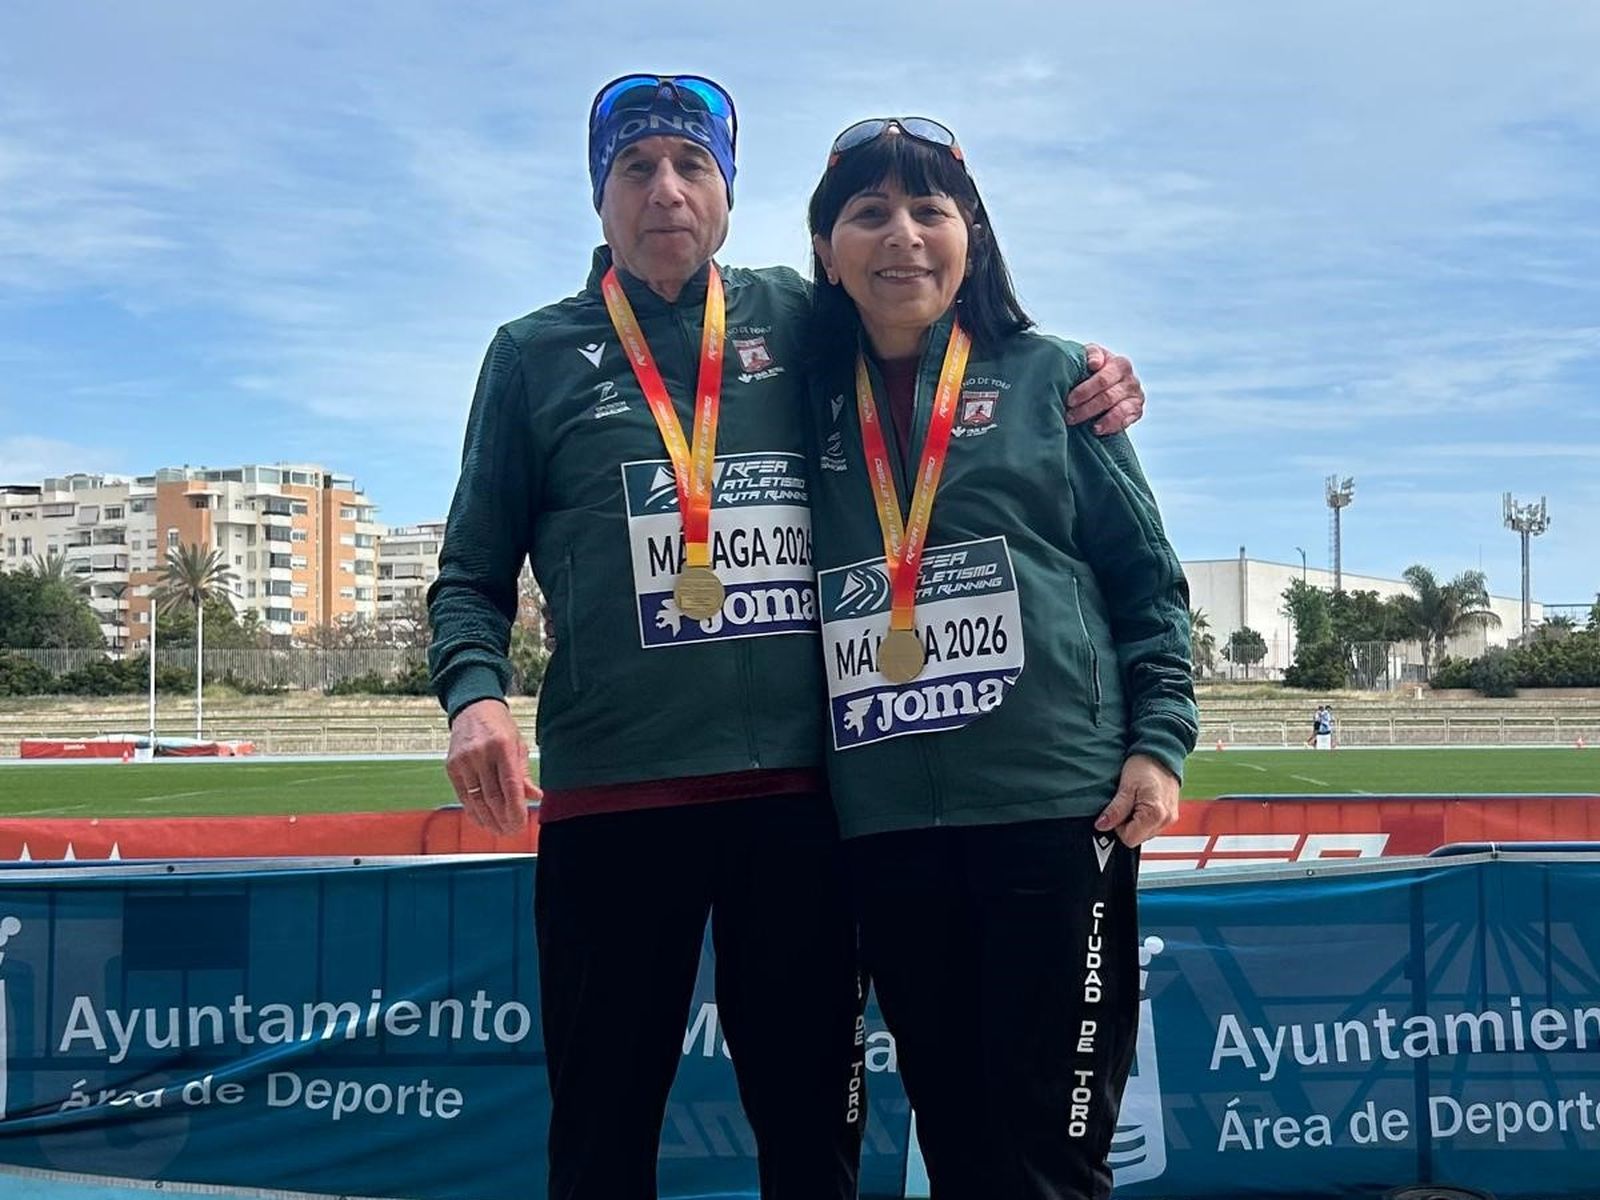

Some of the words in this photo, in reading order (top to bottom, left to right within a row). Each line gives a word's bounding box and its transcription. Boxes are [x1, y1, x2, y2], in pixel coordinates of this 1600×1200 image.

[726, 460, 788, 477] RFEA
[717, 490, 760, 504] RUTA
[647, 525, 770, 577] MÁAGA
[916, 563, 998, 586] LETISMO
[919, 551, 968, 575] FEA
[936, 576, 1004, 596] RUNNING
[944, 614, 1008, 661] 2026
[1084, 902, 1105, 1003] CIUDAD
[59, 989, 531, 1063] Ayuntamiento
[1077, 1020, 1097, 1053] DE
[182, 1074, 245, 1105] de
[266, 1071, 464, 1121] Deporte
[846, 1060, 863, 1123] TORO
[1068, 1070, 1094, 1137] TORO
[1217, 1096, 1333, 1153] Área
[1349, 1101, 1409, 1144] de
[1428, 1089, 1600, 1143] Deport
